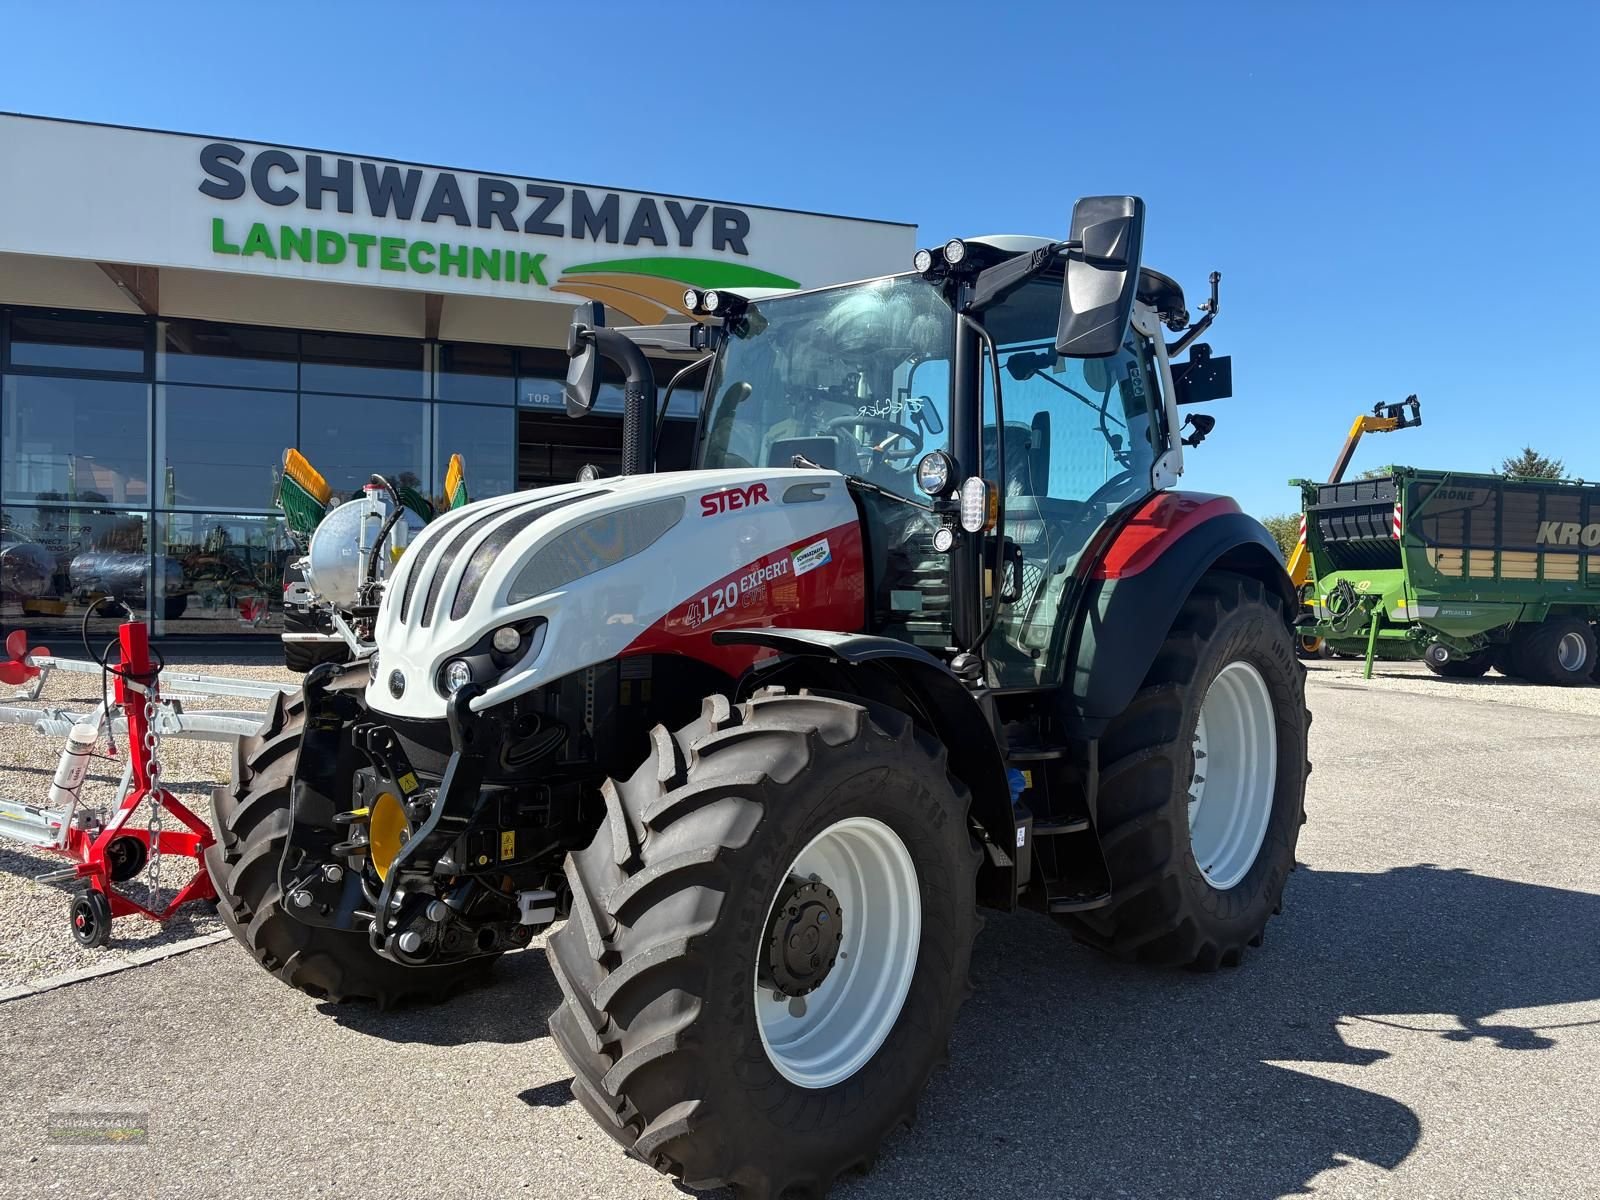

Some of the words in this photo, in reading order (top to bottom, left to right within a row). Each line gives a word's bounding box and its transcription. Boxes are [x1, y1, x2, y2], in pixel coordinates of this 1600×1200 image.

[198, 143, 751, 256] SCHWARZMAYR
[212, 218, 549, 286] LANDTECHNIK
[528, 393, 550, 404] TOR
[700, 482, 770, 517] STEYR
[740, 558, 789, 593] EXPERT
